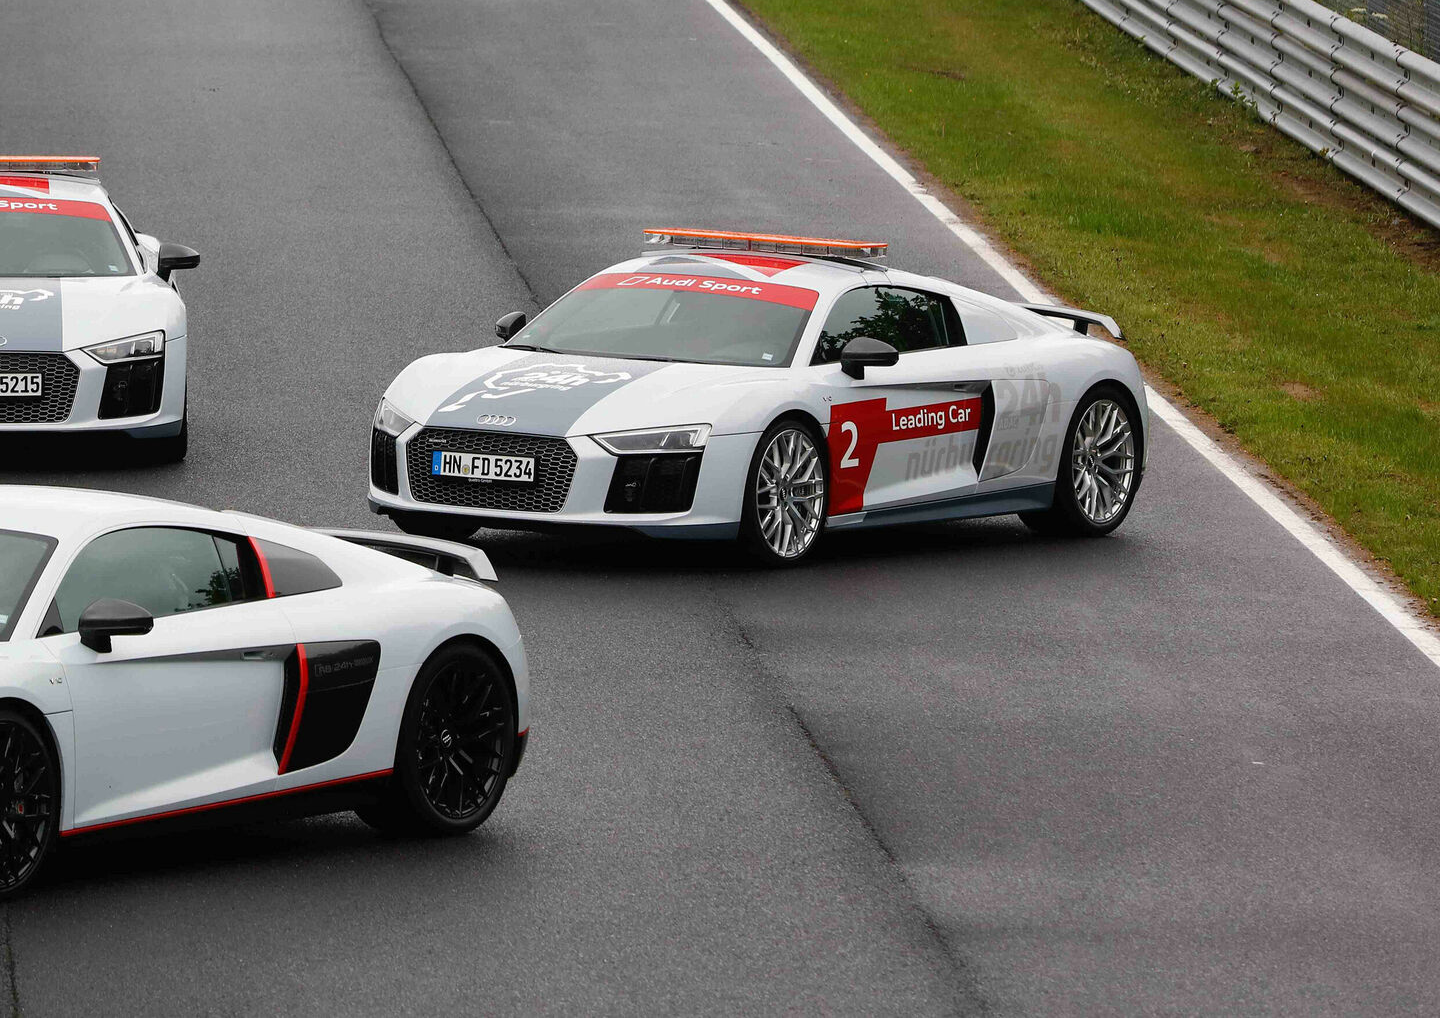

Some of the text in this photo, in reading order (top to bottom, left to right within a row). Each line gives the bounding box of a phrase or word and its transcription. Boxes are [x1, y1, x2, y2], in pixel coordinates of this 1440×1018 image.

[644, 277, 762, 295] Audi Sport
[0, 376, 40, 393] 5215
[891, 405, 971, 431] Leading Car
[840, 420, 860, 469] 2
[443, 454, 462, 474] HN
[471, 456, 491, 476] FD
[494, 458, 532, 479] 5234
